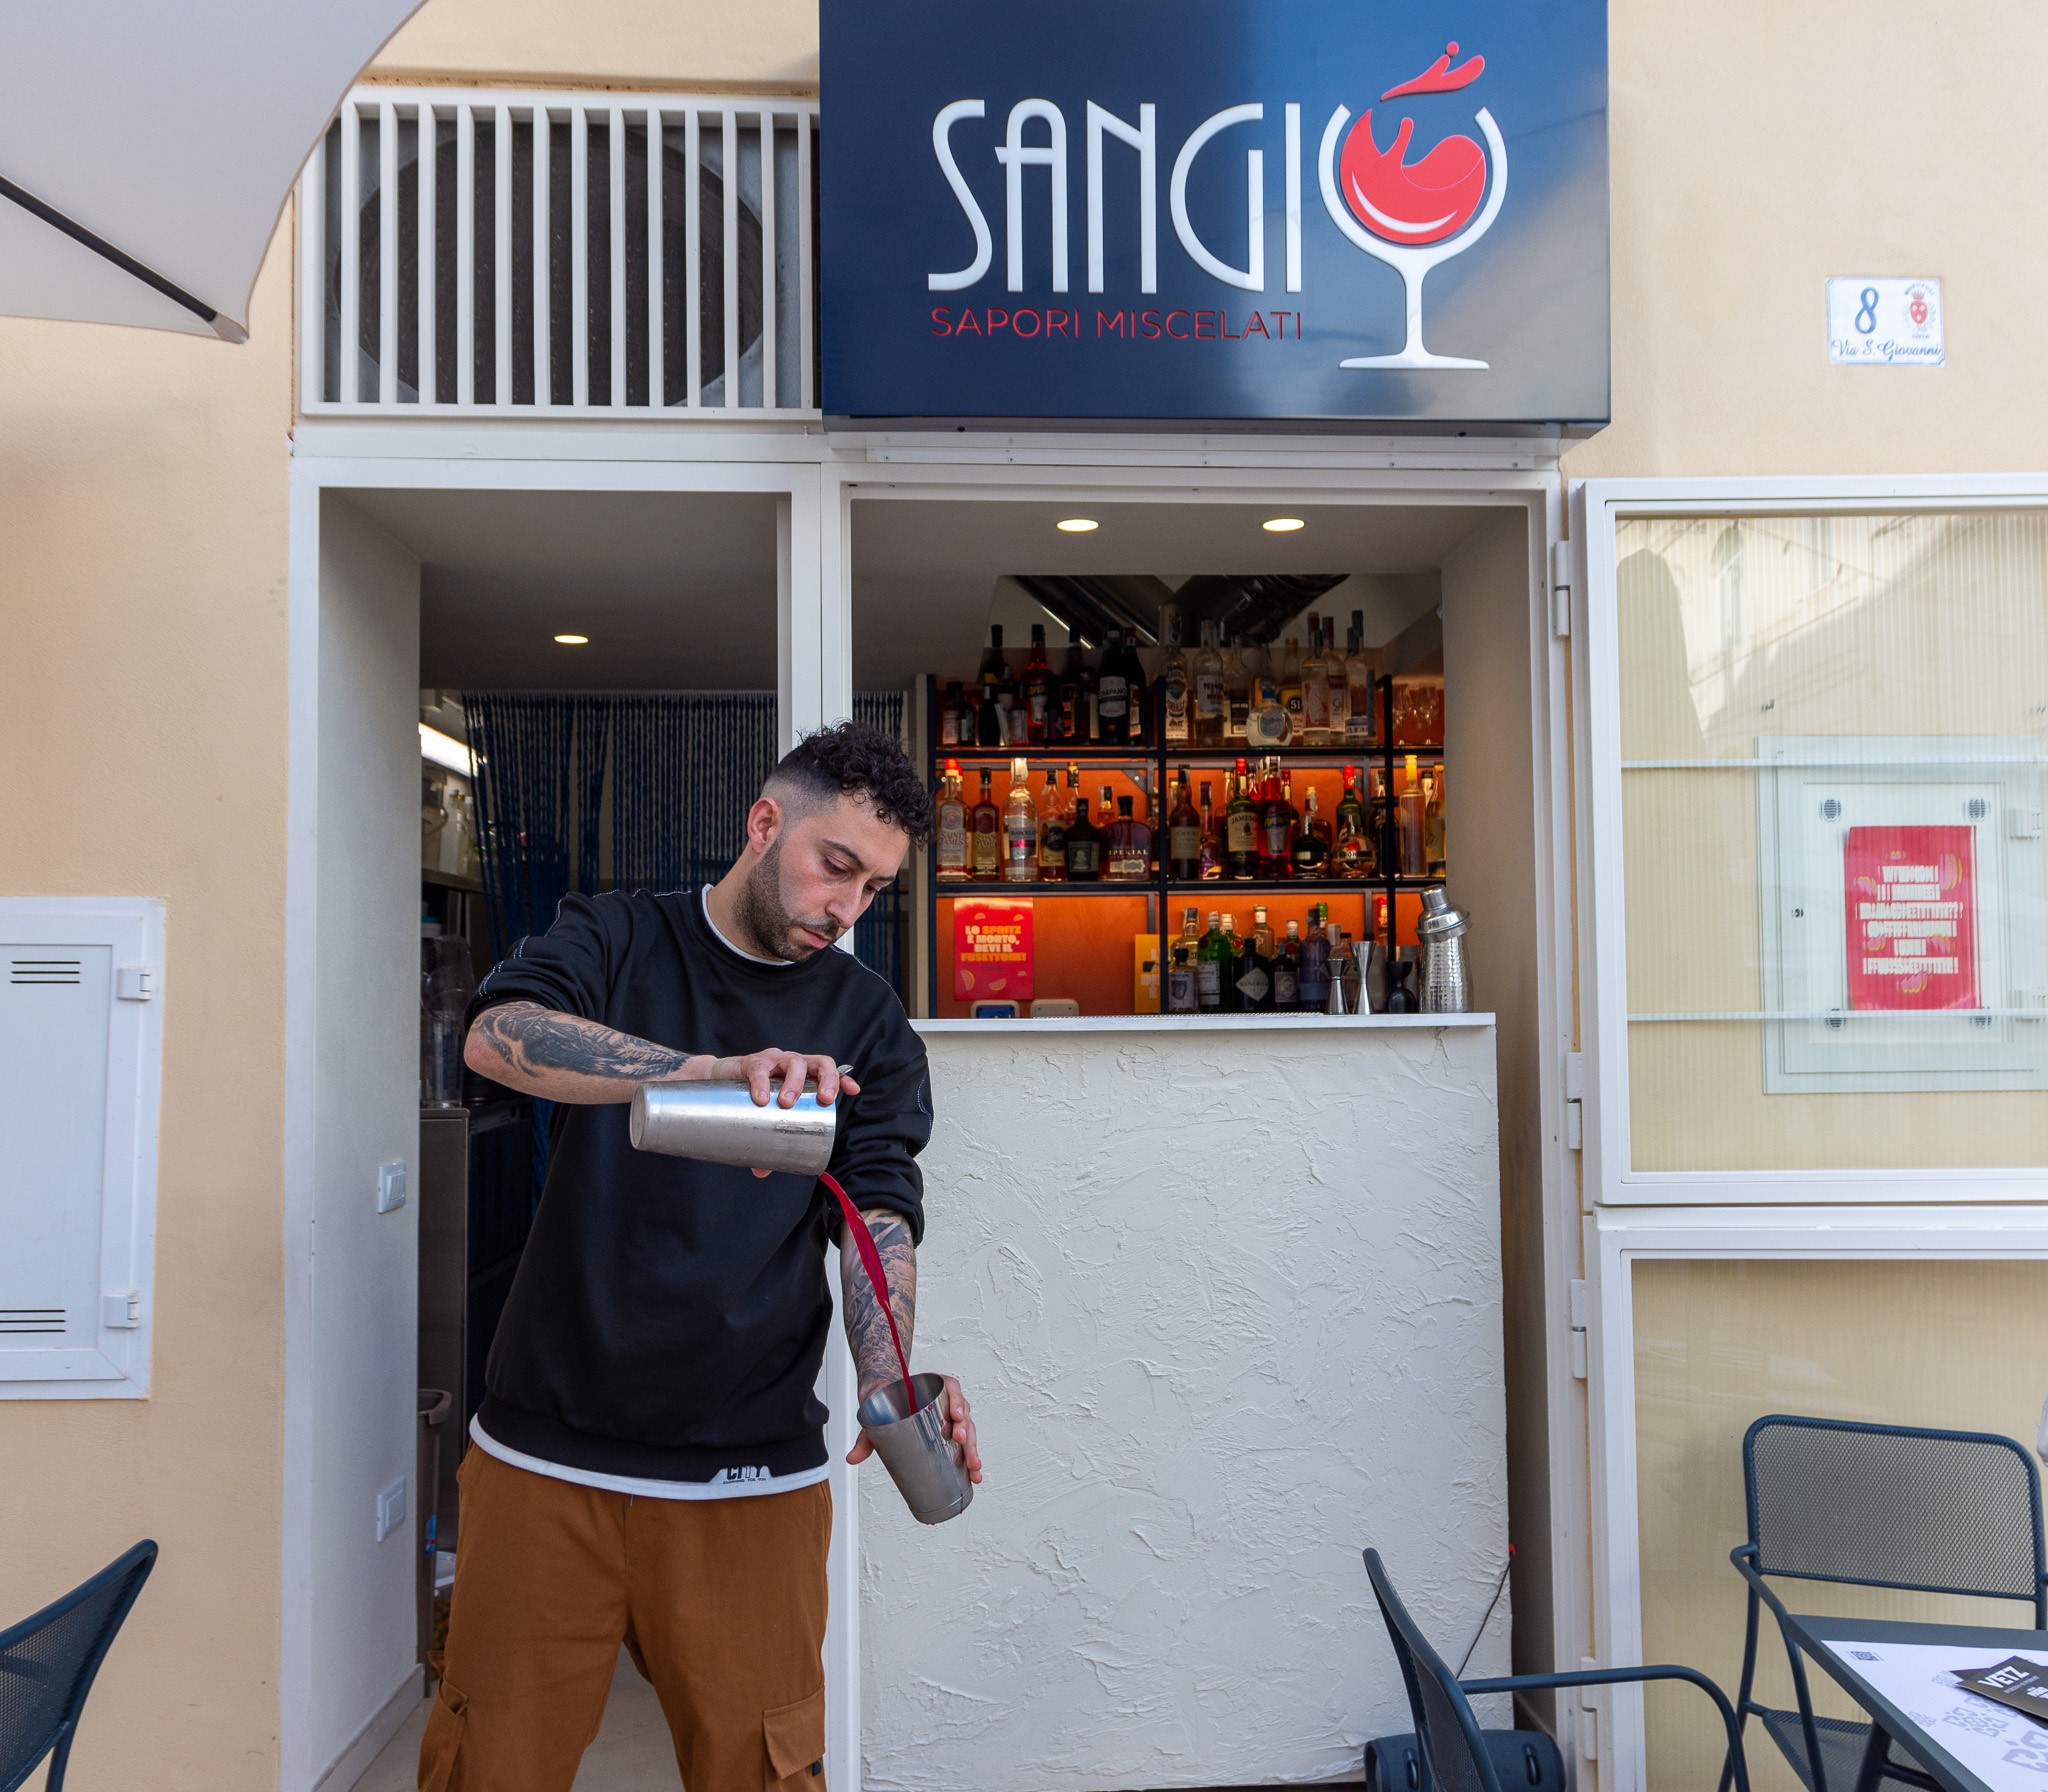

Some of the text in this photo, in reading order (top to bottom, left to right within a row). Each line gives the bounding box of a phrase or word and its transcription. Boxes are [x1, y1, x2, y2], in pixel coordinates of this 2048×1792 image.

[930, 307, 1302, 341] SAPORI MISCELATI
[1854, 286, 1880, 334] 8
[1831, 339, 1859, 356] Via
[1877, 340, 1943, 362] Giovanni
[1976, 1665, 2031, 1689] VETZ
